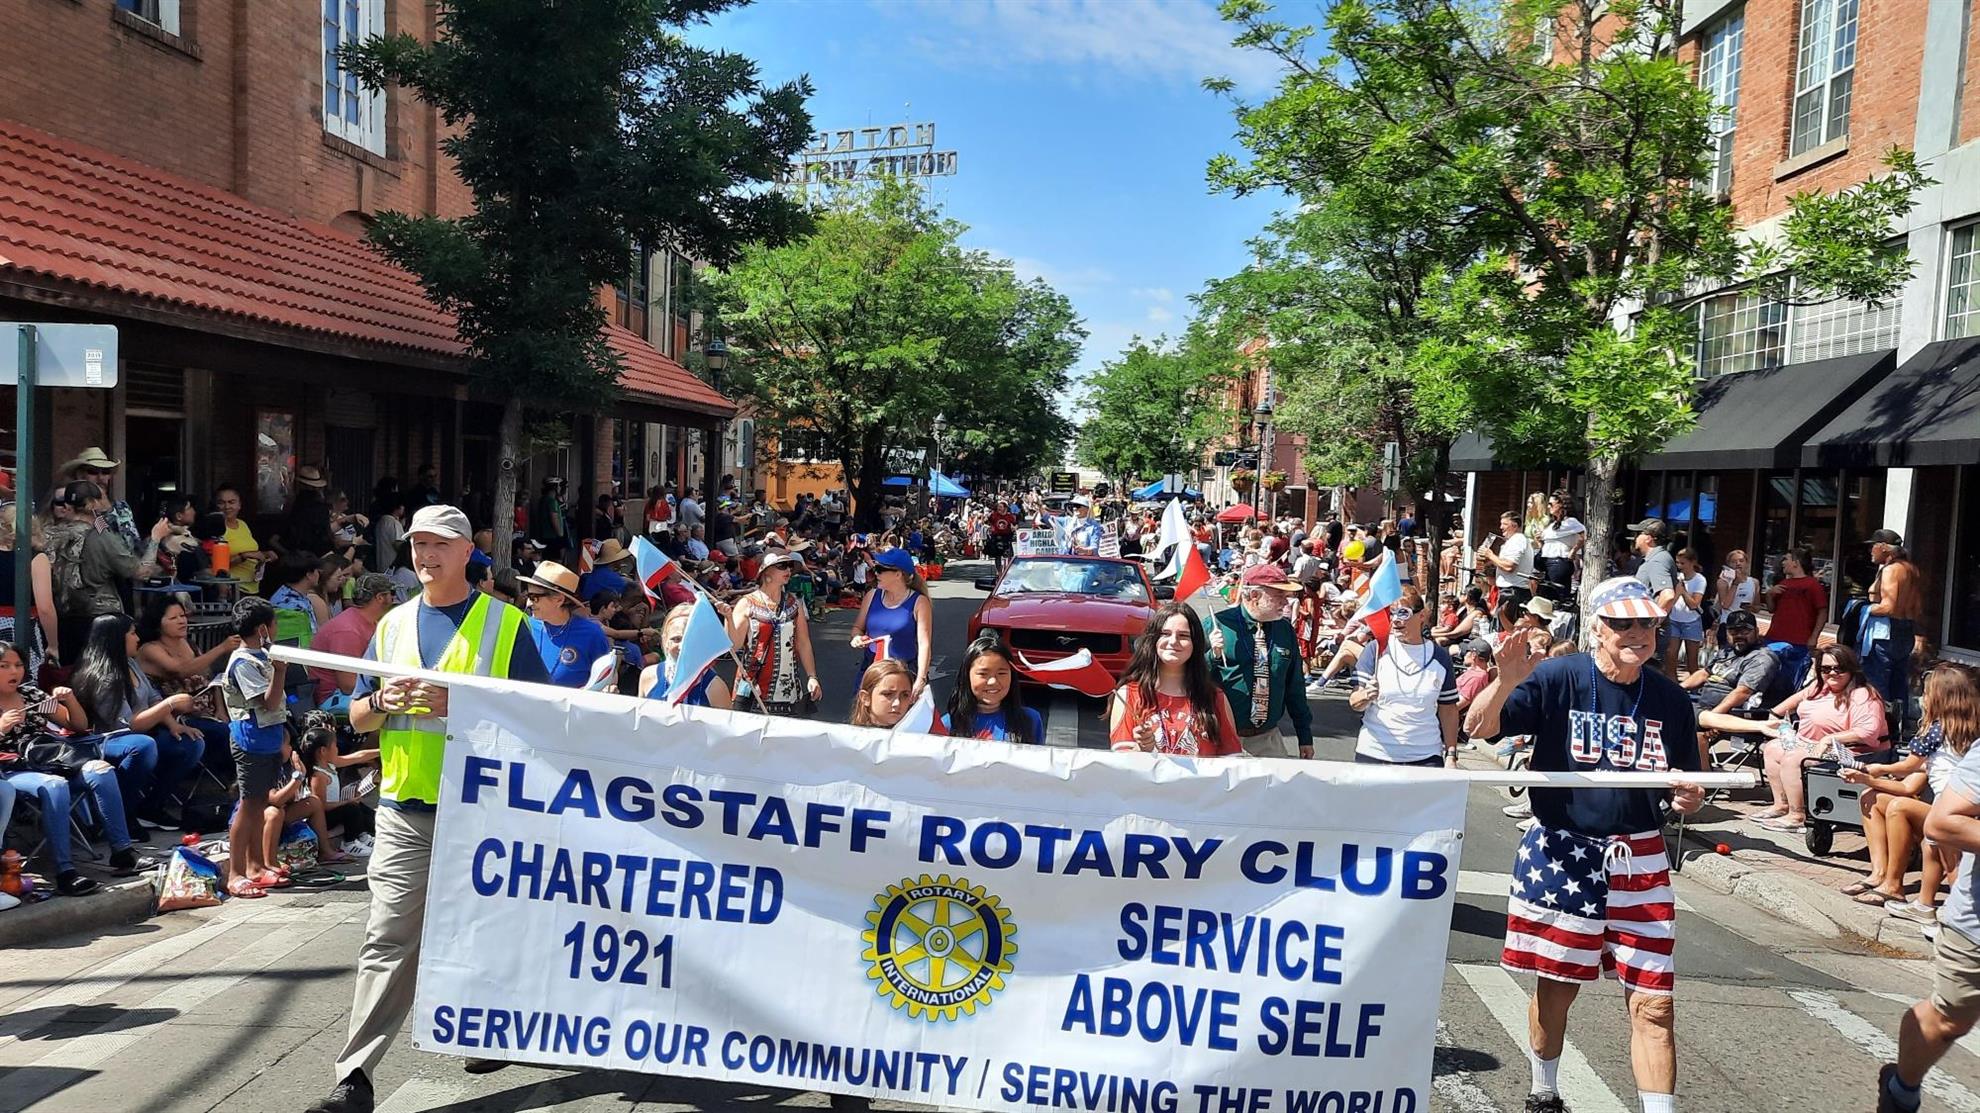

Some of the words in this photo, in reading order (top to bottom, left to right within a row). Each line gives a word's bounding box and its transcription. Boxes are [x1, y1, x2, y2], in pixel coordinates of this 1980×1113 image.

[1030, 539, 1057, 548] HIGHLA
[1569, 709, 1669, 772] USA
[461, 755, 891, 853] FLAGSTAFF
[918, 815, 1223, 879] ROTARY
[1239, 840, 1449, 900] CLUB
[472, 838, 784, 925] CHARTERED
[910, 886, 977, 904] ROTARY
[564, 921, 673, 989] 1921
[1117, 902, 1345, 985] SERVICE
[881, 959, 993, 1006] INTERNATIONAL
[1062, 973, 1240, 1051] ABOVE
[1257, 996, 1385, 1059] SELF
[433, 1005, 611, 1056] SERVING
[625, 1020, 709, 1066] OUR
[721, 1031, 968, 1095] COMMUNITY
[1001, 1062, 1178, 1113] SERVING
[1193, 1085, 1273, 1113] THE
